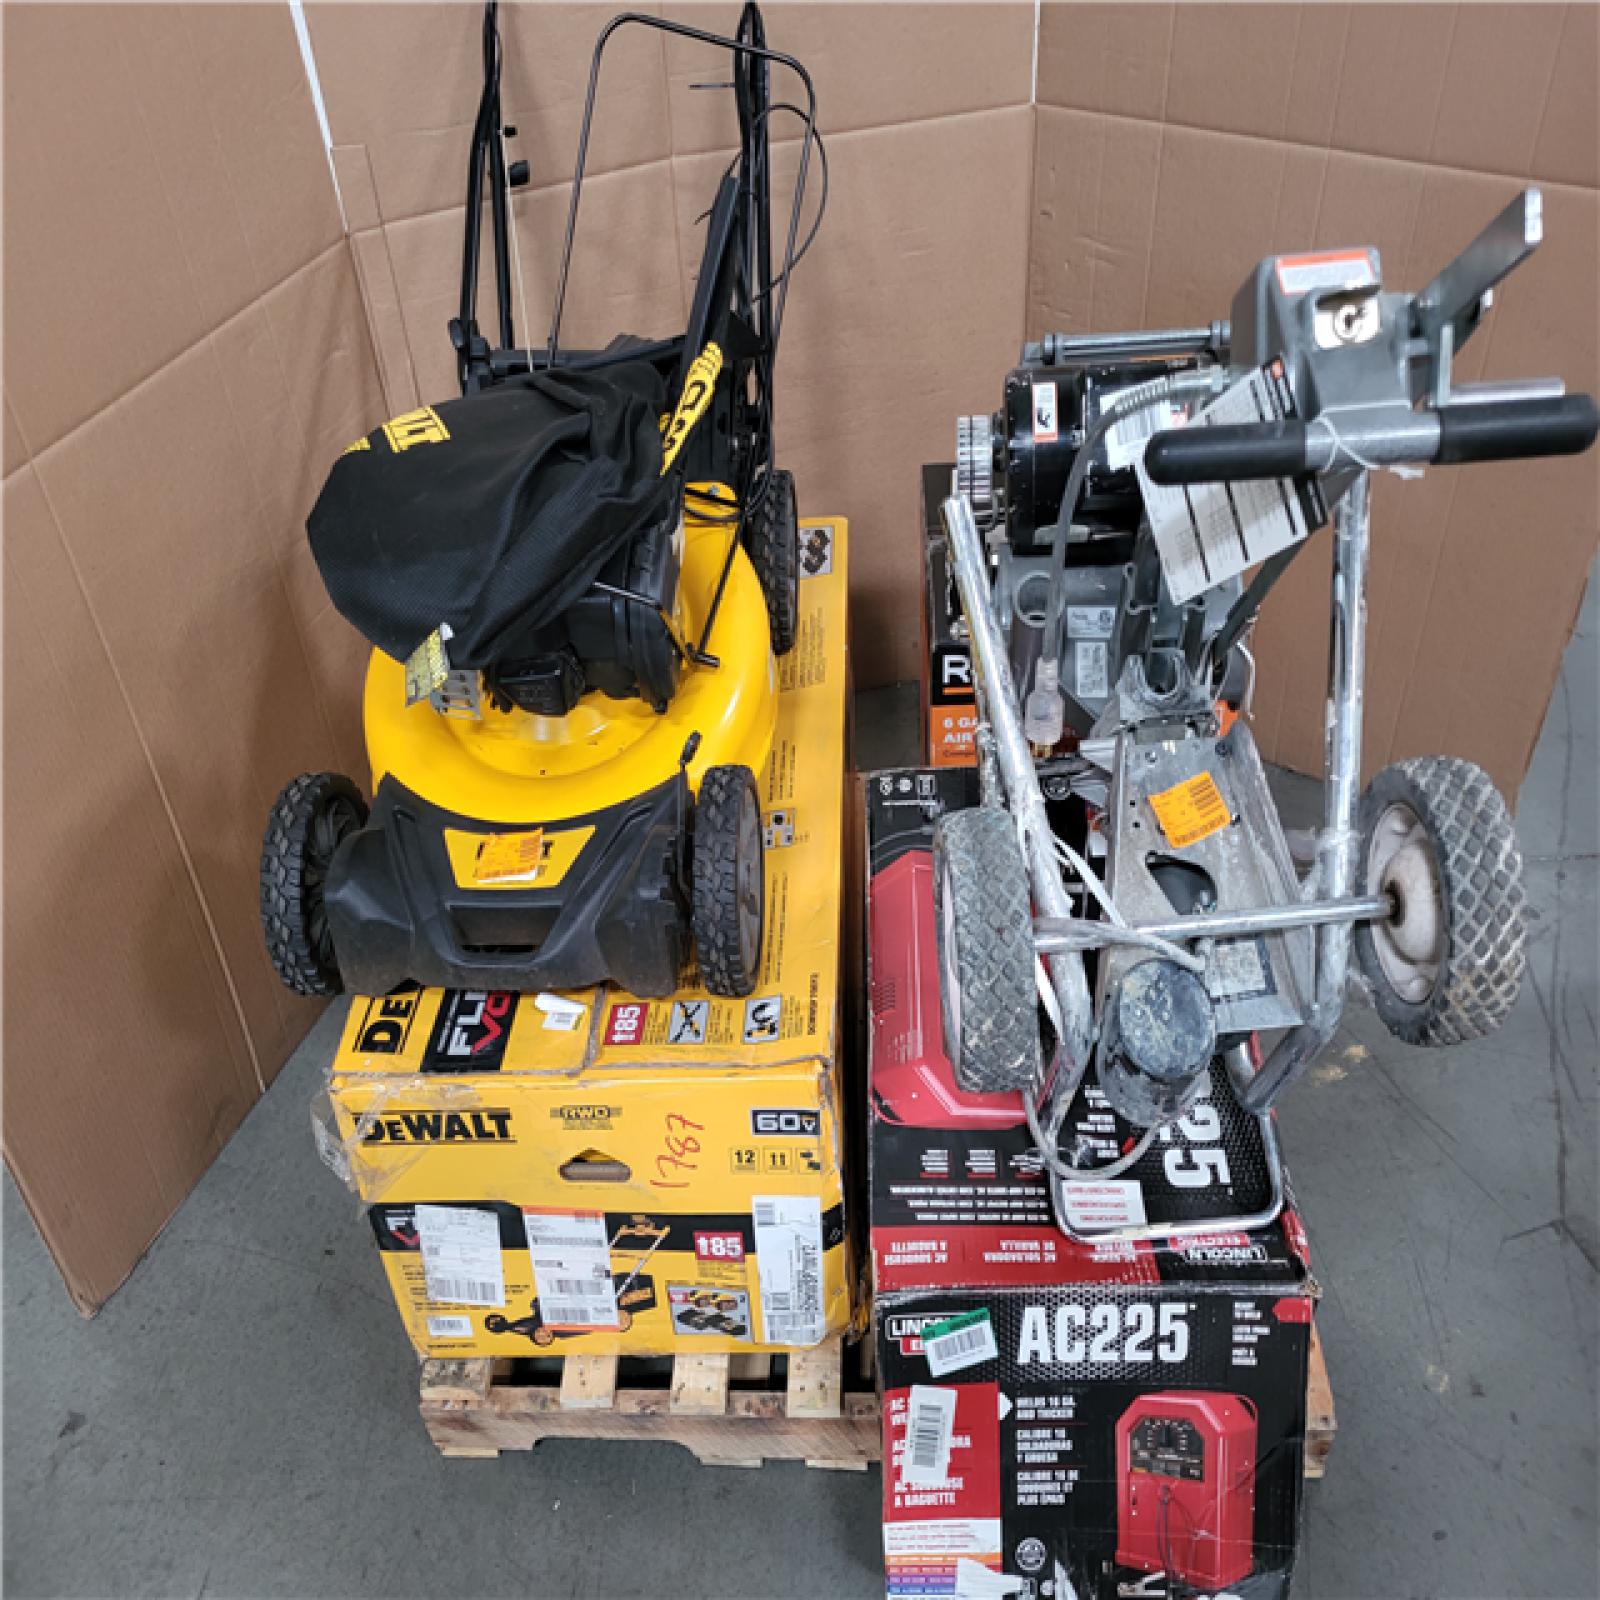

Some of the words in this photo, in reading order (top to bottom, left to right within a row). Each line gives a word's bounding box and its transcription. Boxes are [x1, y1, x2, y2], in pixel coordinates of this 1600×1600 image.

[942, 654, 972, 684] R
[360, 992, 415, 1052] DE
[470, 990, 512, 1054] VO
[611, 1006, 641, 1043] 185
[735, 1149, 755, 1164] 12
[771, 1151, 786, 1166] 11
[697, 1236, 741, 1256] 185
[1017, 1303, 1190, 1365] AC225
